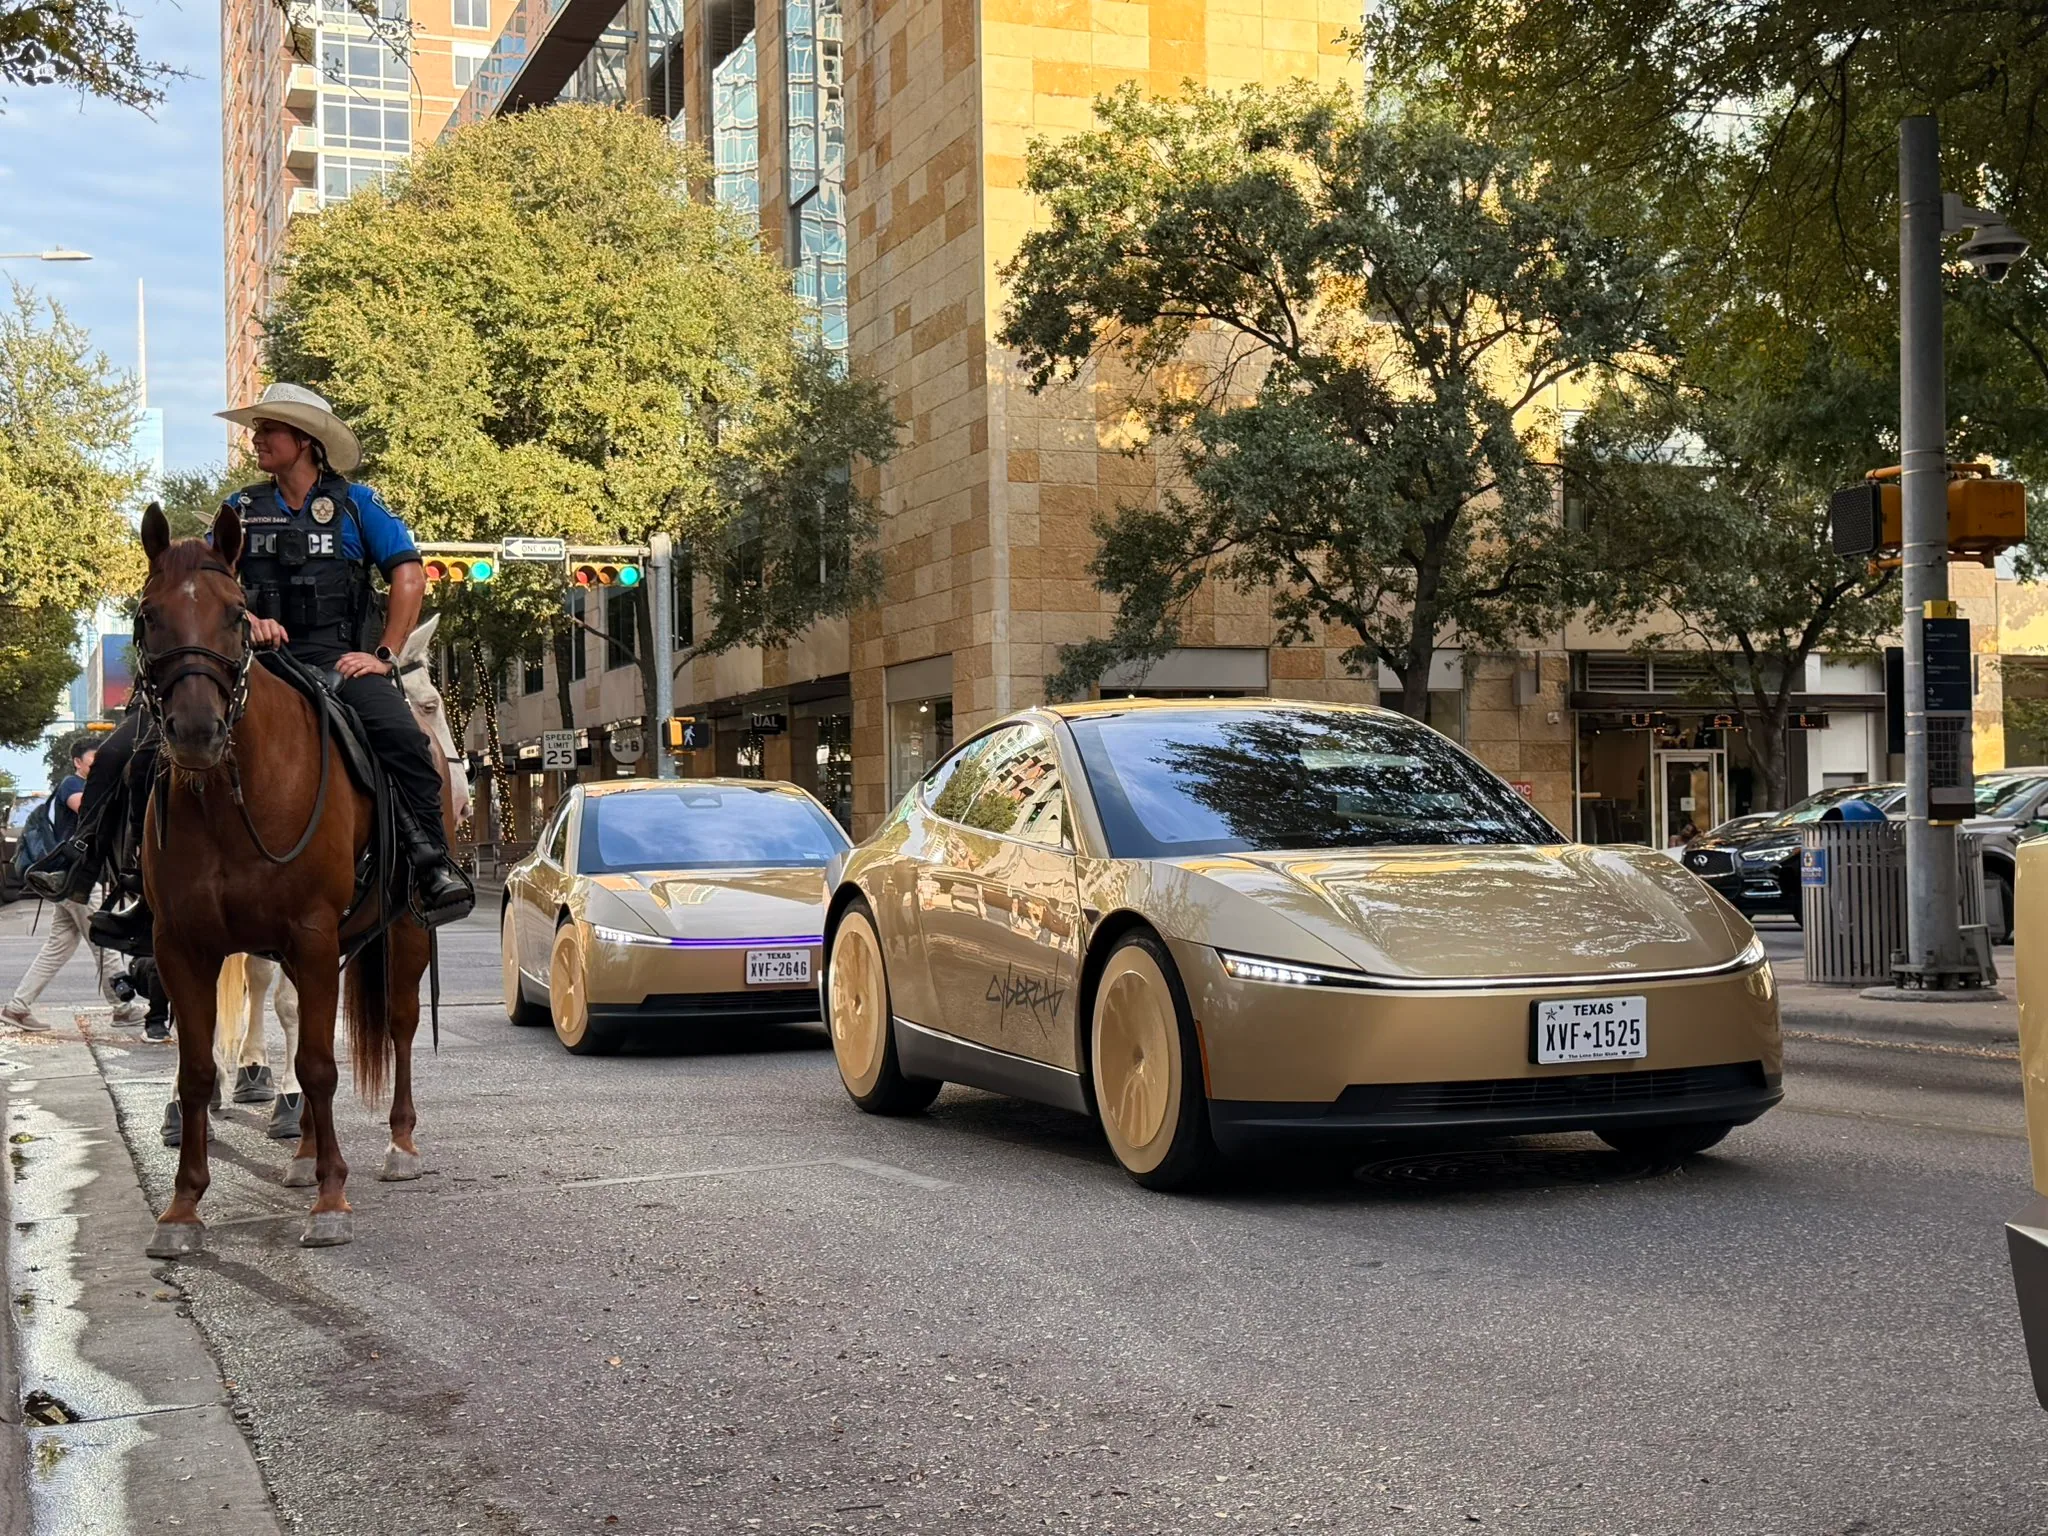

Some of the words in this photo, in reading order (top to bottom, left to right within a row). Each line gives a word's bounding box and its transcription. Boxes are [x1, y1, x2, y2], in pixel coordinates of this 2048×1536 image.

[251, 533, 334, 554] POCE
[522, 544, 538, 553] ONE
[541, 544, 557, 553] WAY
[546, 750, 573, 765] 25
[767, 952, 792, 960] TEXAS
[1573, 1003, 1614, 1016] TEXAS
